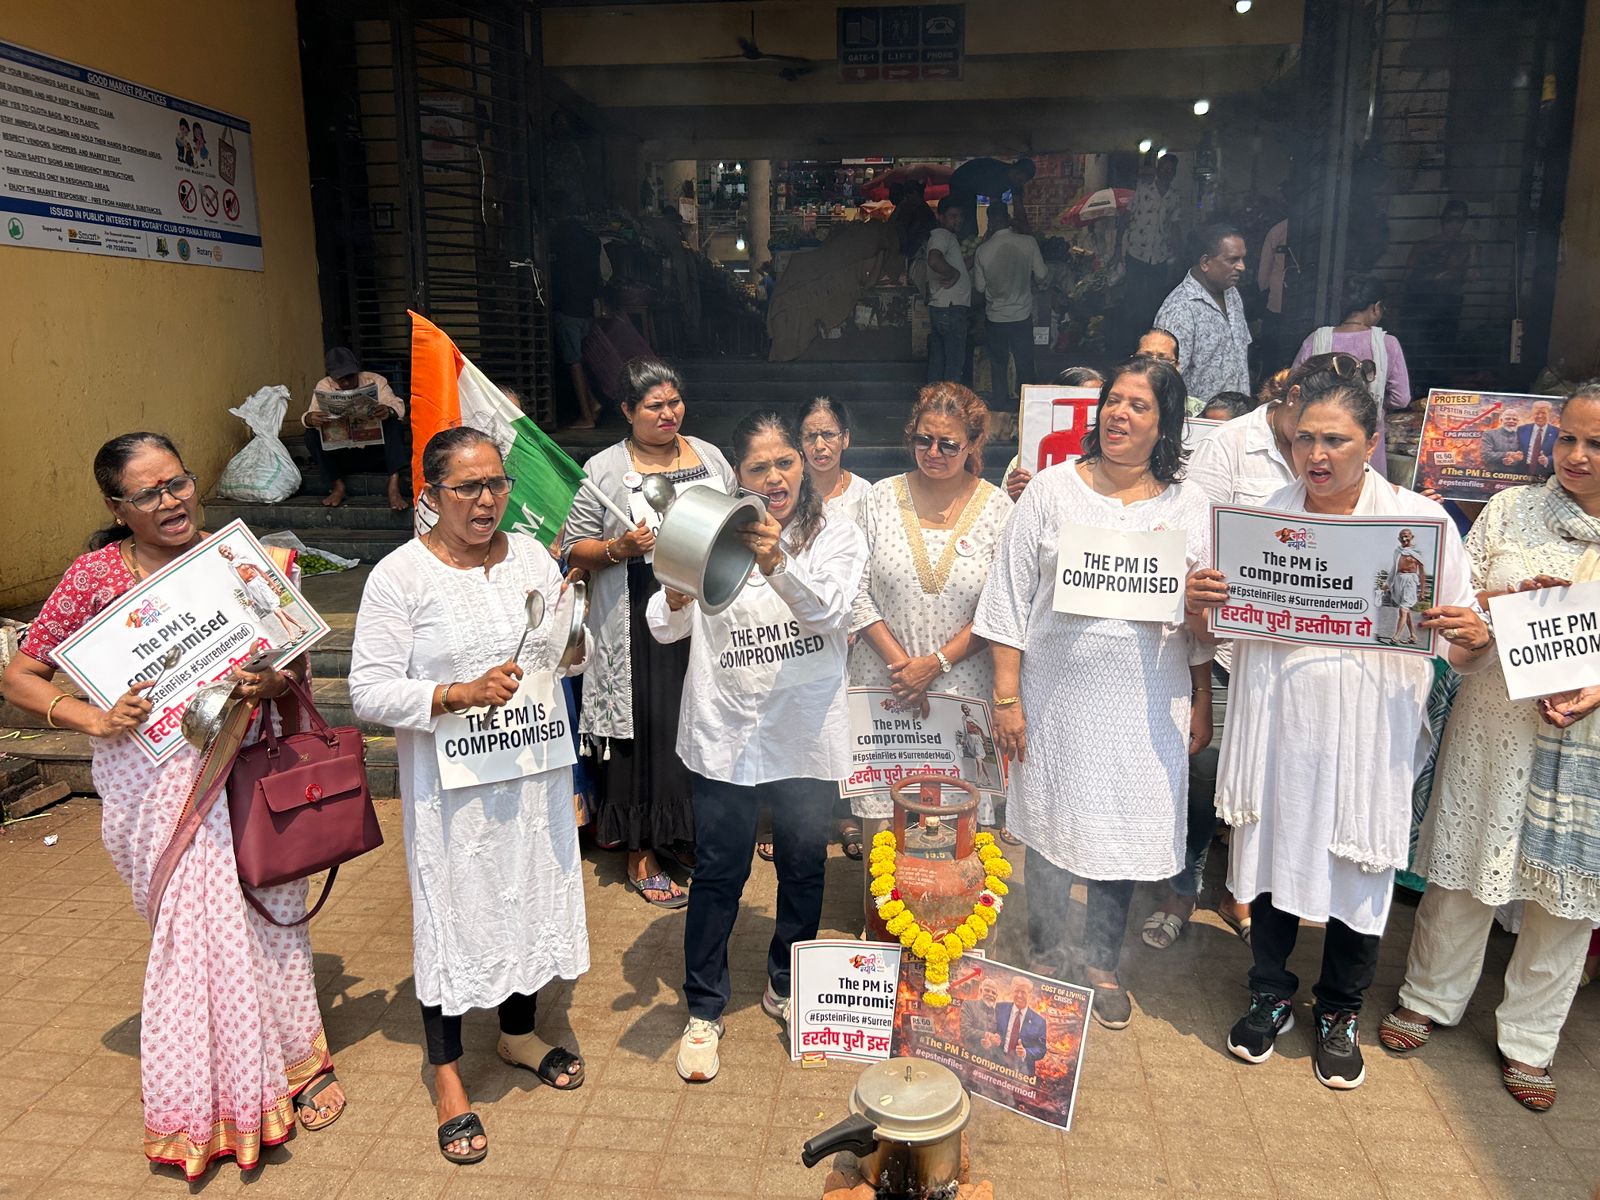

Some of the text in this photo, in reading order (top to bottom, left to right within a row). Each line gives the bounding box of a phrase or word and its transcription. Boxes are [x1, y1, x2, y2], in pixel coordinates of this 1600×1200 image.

[927, 51, 953, 59] PHONE
[87, 72, 167, 106] GOOD MARKET PRACTICES
[10, 100, 20, 109] YES
[22, 104, 29, 112] TO
[64, 114, 71, 122] NO
[72, 116, 79, 124] TO
[34, 90, 44, 100] AND
[58, 96, 70, 106] KEEP
[70, 100, 79, 109] THE
[80, 102, 98, 115] MARKET
[2, 132, 24, 144] RESPECT
[90, 151, 106, 161] MARKET
[46, 125, 69, 137] CHILDREN
[71, 130, 80, 138] AND
[81, 132, 93, 143] HOLD
[94, 137, 106, 146] THEIR
[4, 149, 26, 159] FOLLOW
[28, 154, 47, 164] SAFETY
[48, 158, 63, 167] SIGNS
[75, 163, 102, 174] EMERGENCY
[7, 166, 20, 174] PARK
[21, 169, 45, 179] VEHICLES
[47, 174, 58, 182] ONLY
[66, 178, 94, 188] DESIGNATED
[8, 183, 25, 192] ENJOY
[26, 186, 36, 194] THE
[37, 187, 56, 197] MARKET
[58, 191, 87, 202] RESPONSIBLY
[50, 206, 74, 217] ISSUED
[75, 211, 81, 219] IN
[83, 212, 104, 222] PUBLIC
[106, 215, 132, 227] INTEREST
[142, 221, 162, 231] ROTARY
[164, 224, 177, 233] CLUB
[186, 227, 202, 236] PANAJI
[204, 229, 221, 239] RIVIERA
[197, 247, 212, 258] Rotary
[1435, 396, 1472, 404] PROTEST
[1440, 406, 1462, 415] EPSTEIN
[1438, 479, 1484, 488] #epsteinfiles
[1442, 467, 1463, 475] #The
[1465, 468, 1480, 477] PM
[1482, 470, 1490, 478] is
[1084, 552, 1158, 574] THE PM IS
[1262, 551, 1328, 572] The PM is
[1062, 568, 1179, 594] COMPROMISED
[1239, 566, 1353, 591] compromised
[1230, 585, 1363, 610] #EpsteinFiles #SurrenderModi
[1220, 604, 1373, 637] हरदीप पुरी इस्तीफा दो
[1527, 612, 1598, 640] THE PM
[132, 610, 197, 661] The PM is
[731, 620, 800, 647] THE PM IS
[127, 610, 229, 688] compmised
[190, 626, 250, 674] #SurrenderModi
[720, 635, 824, 669] COMPROMISED
[466, 702, 546, 733] THE PM IS
[873, 719, 922, 730] The PM is
[445, 720, 565, 758] COMPROMISED
[858, 732, 942, 746] compromised
[852, 751, 952, 762] #EpsteinFiles #SurrenderModi
[884, 764, 903, 785] पुरी
[838, 977, 894, 993] The PM is
[1041, 984, 1056, 994] COST
[1066, 990, 1086, 1001] LIVING
[818, 993, 894, 1009] compromis
[1054, 994, 1073, 1004] CRISIS
[810, 1012, 892, 1027] #EpsteinFiles #Surren
[802, 1027, 864, 1051] हरदीप पुरी
[920, 1035, 1036, 1086] #The PM is compromised
[916, 1048, 1037, 1099] #epsteinfiles #surrendermodi
